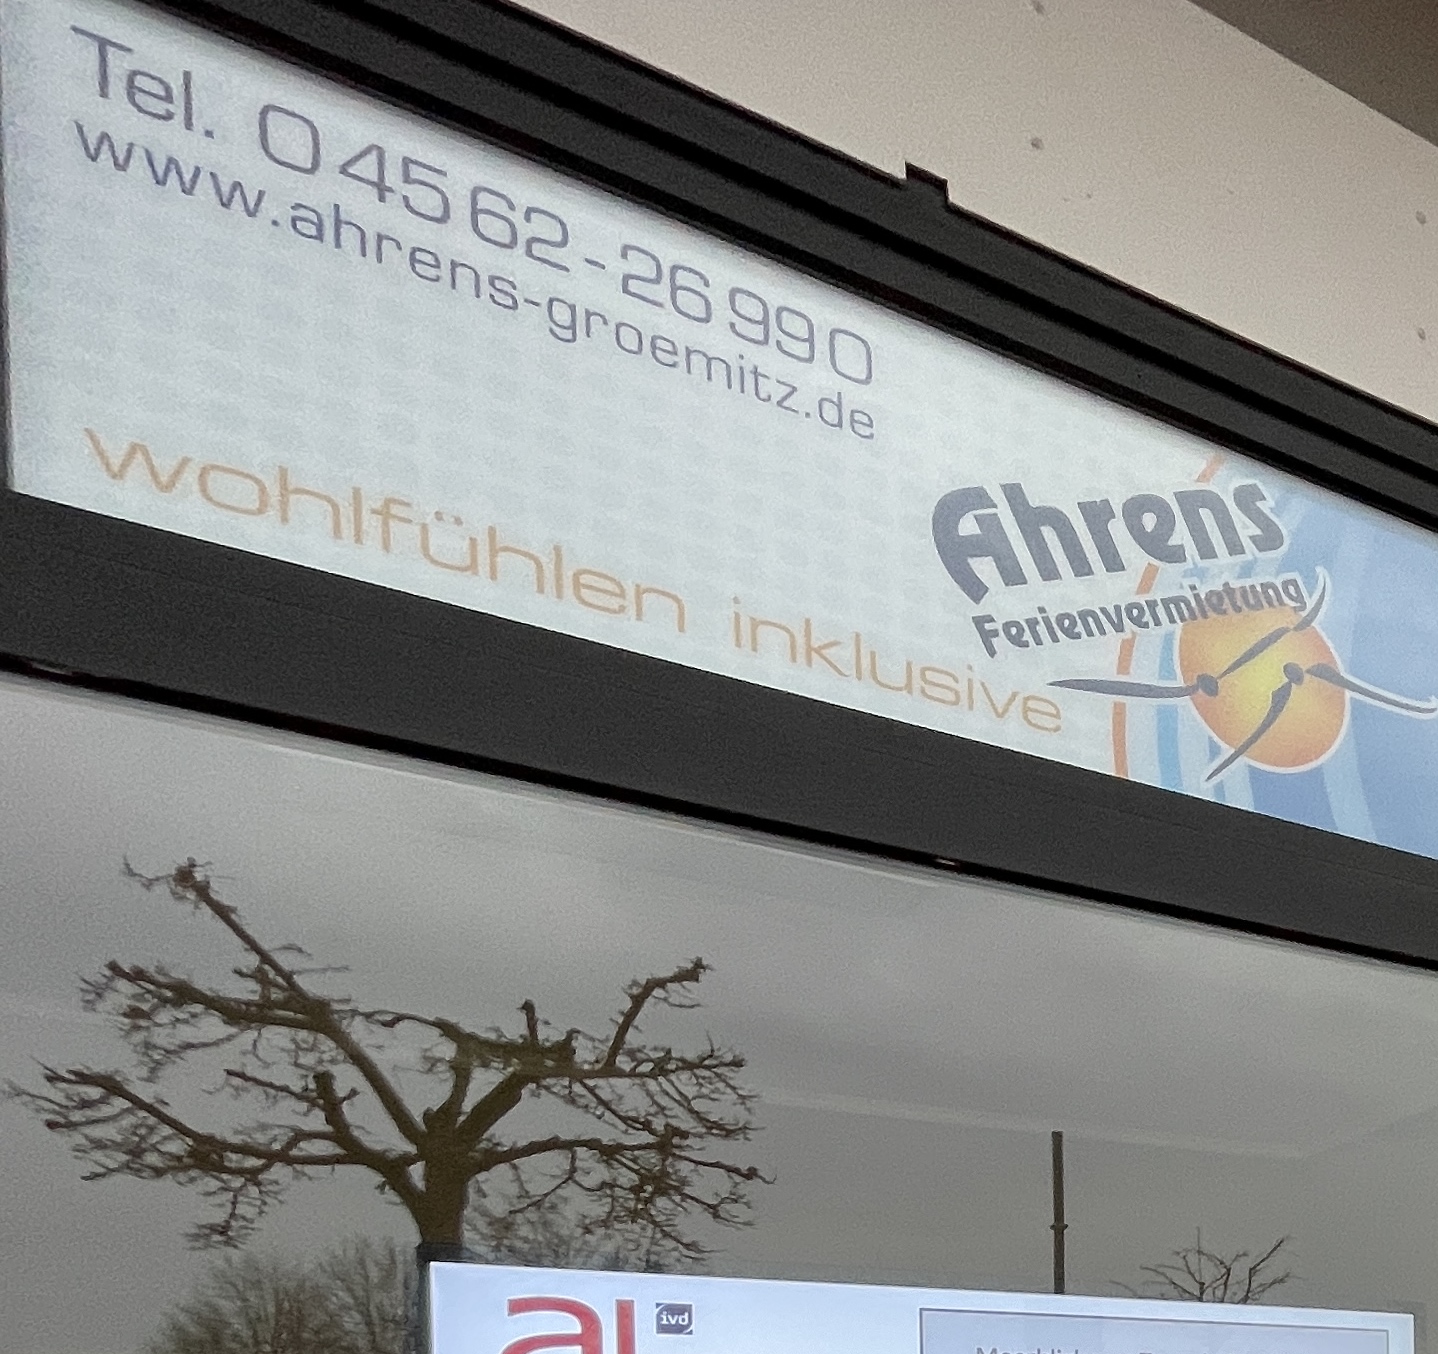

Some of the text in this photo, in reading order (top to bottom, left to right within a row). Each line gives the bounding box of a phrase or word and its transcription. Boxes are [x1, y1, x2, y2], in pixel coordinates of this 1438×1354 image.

[70, 25, 215, 138] Tel.
[74, 120, 875, 441] www.ahrens-groemitz.de
[83, 427, 1063, 734] wohlfühlen inklusive
[931, 482, 1285, 604] Ahrens
[971, 574, 1305, 658] Ferienvermietung
[660, 1311, 689, 1325] ivd
